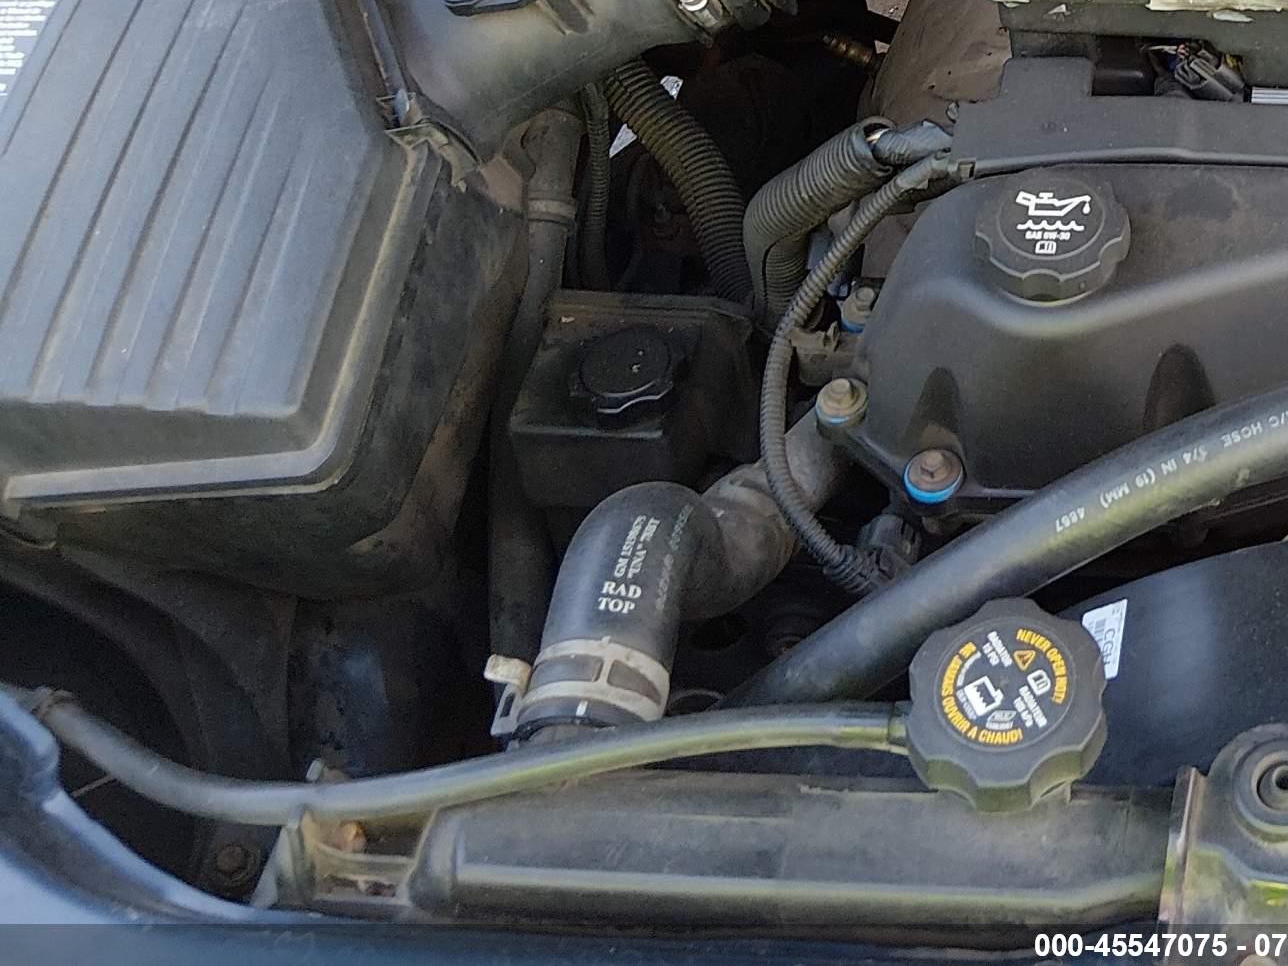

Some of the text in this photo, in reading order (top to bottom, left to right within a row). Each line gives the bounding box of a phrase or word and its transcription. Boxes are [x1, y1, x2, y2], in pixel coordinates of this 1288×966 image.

[1223, 422, 1263, 449] HOSE
[1161, 456, 1178, 476] IN
[1100, 483, 1130, 508] MM)
[602, 581, 642, 599] RAD
[598, 597, 636, 614] TOP
[1015, 628, 1052, 653] NEVER
[1046, 648, 1067, 676] OPEN
[942, 696, 970, 734] OUVRIR
[978, 728, 1024, 745] CHAUD!
